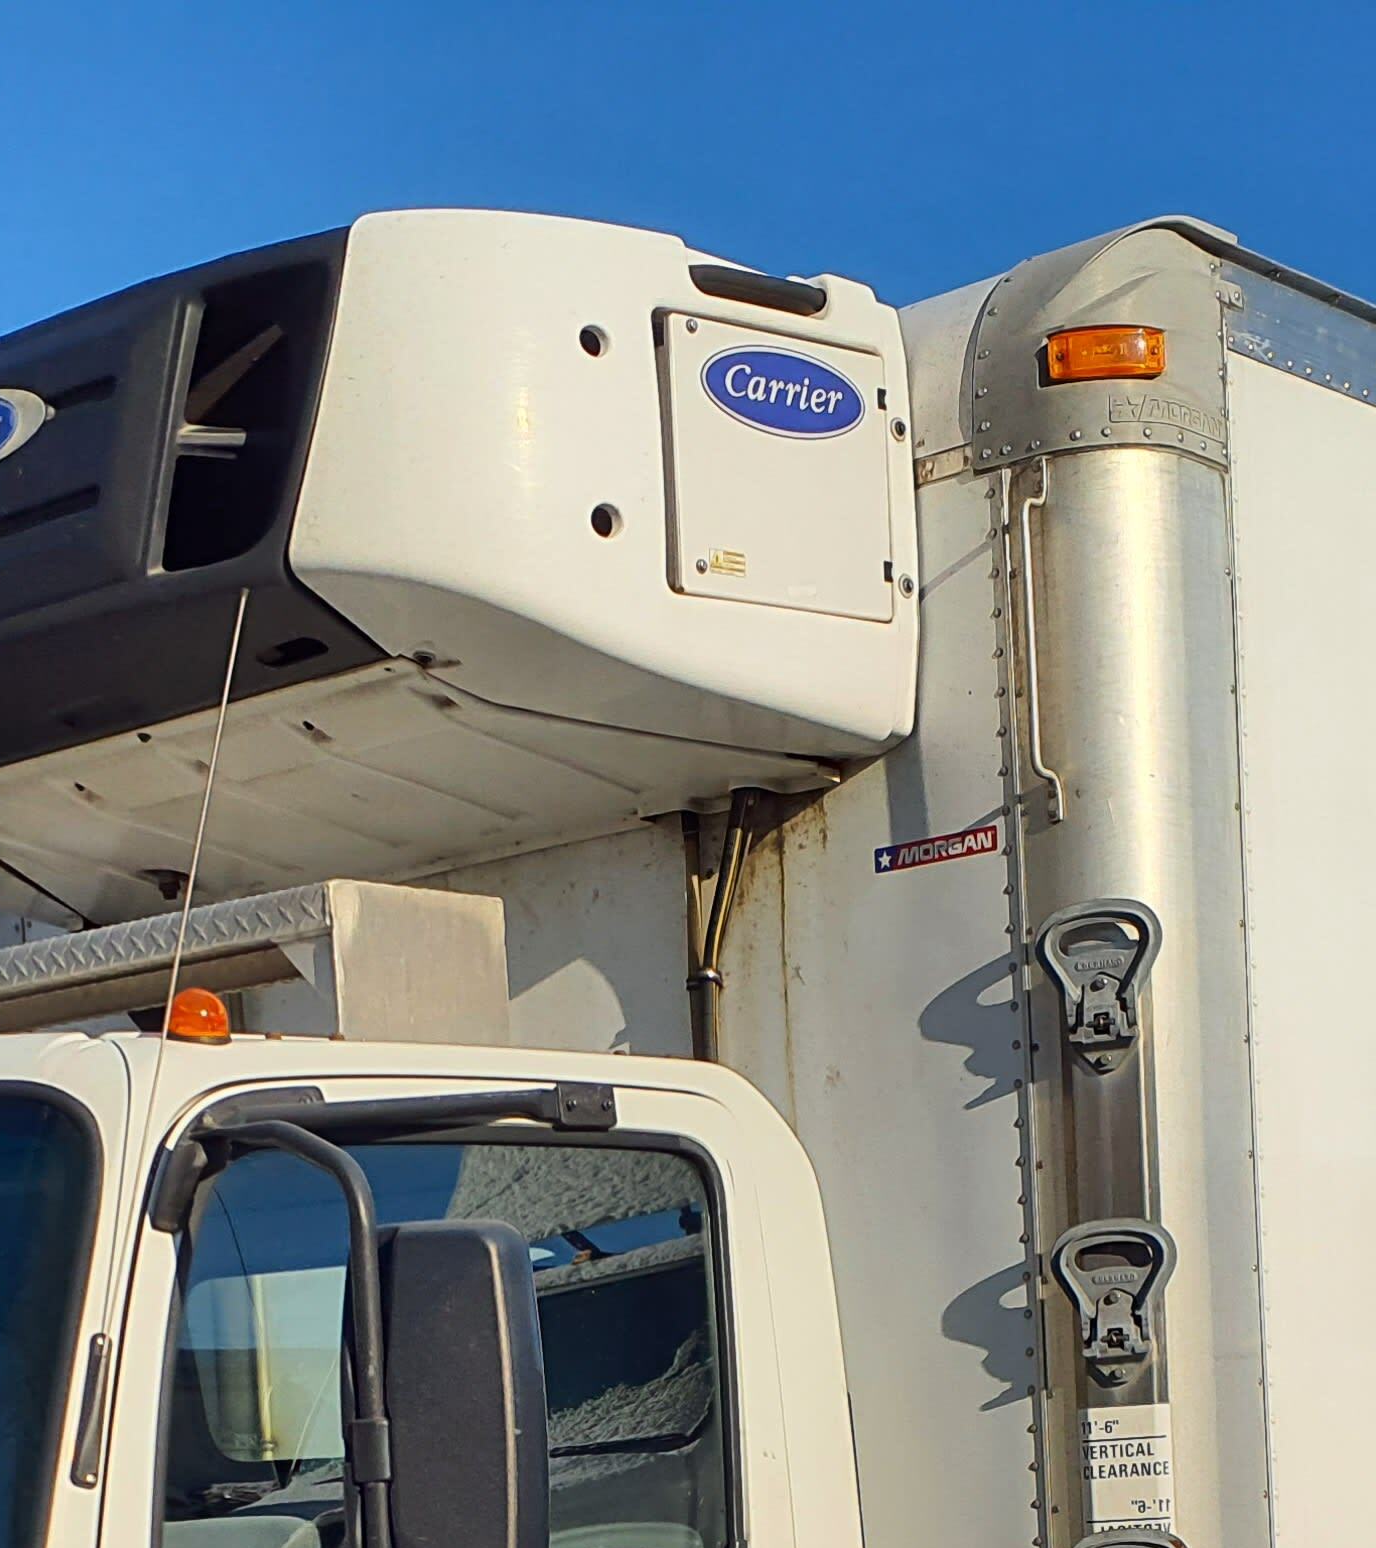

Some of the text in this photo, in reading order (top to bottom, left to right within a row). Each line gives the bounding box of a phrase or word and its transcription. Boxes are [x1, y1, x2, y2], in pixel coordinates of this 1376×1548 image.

[725, 363, 844, 415] Carrier
[897, 831, 993, 866] MORGAN
[1082, 1442, 1155, 1460] VERTICAL
[1083, 1461, 1169, 1480] CLEARANCE
